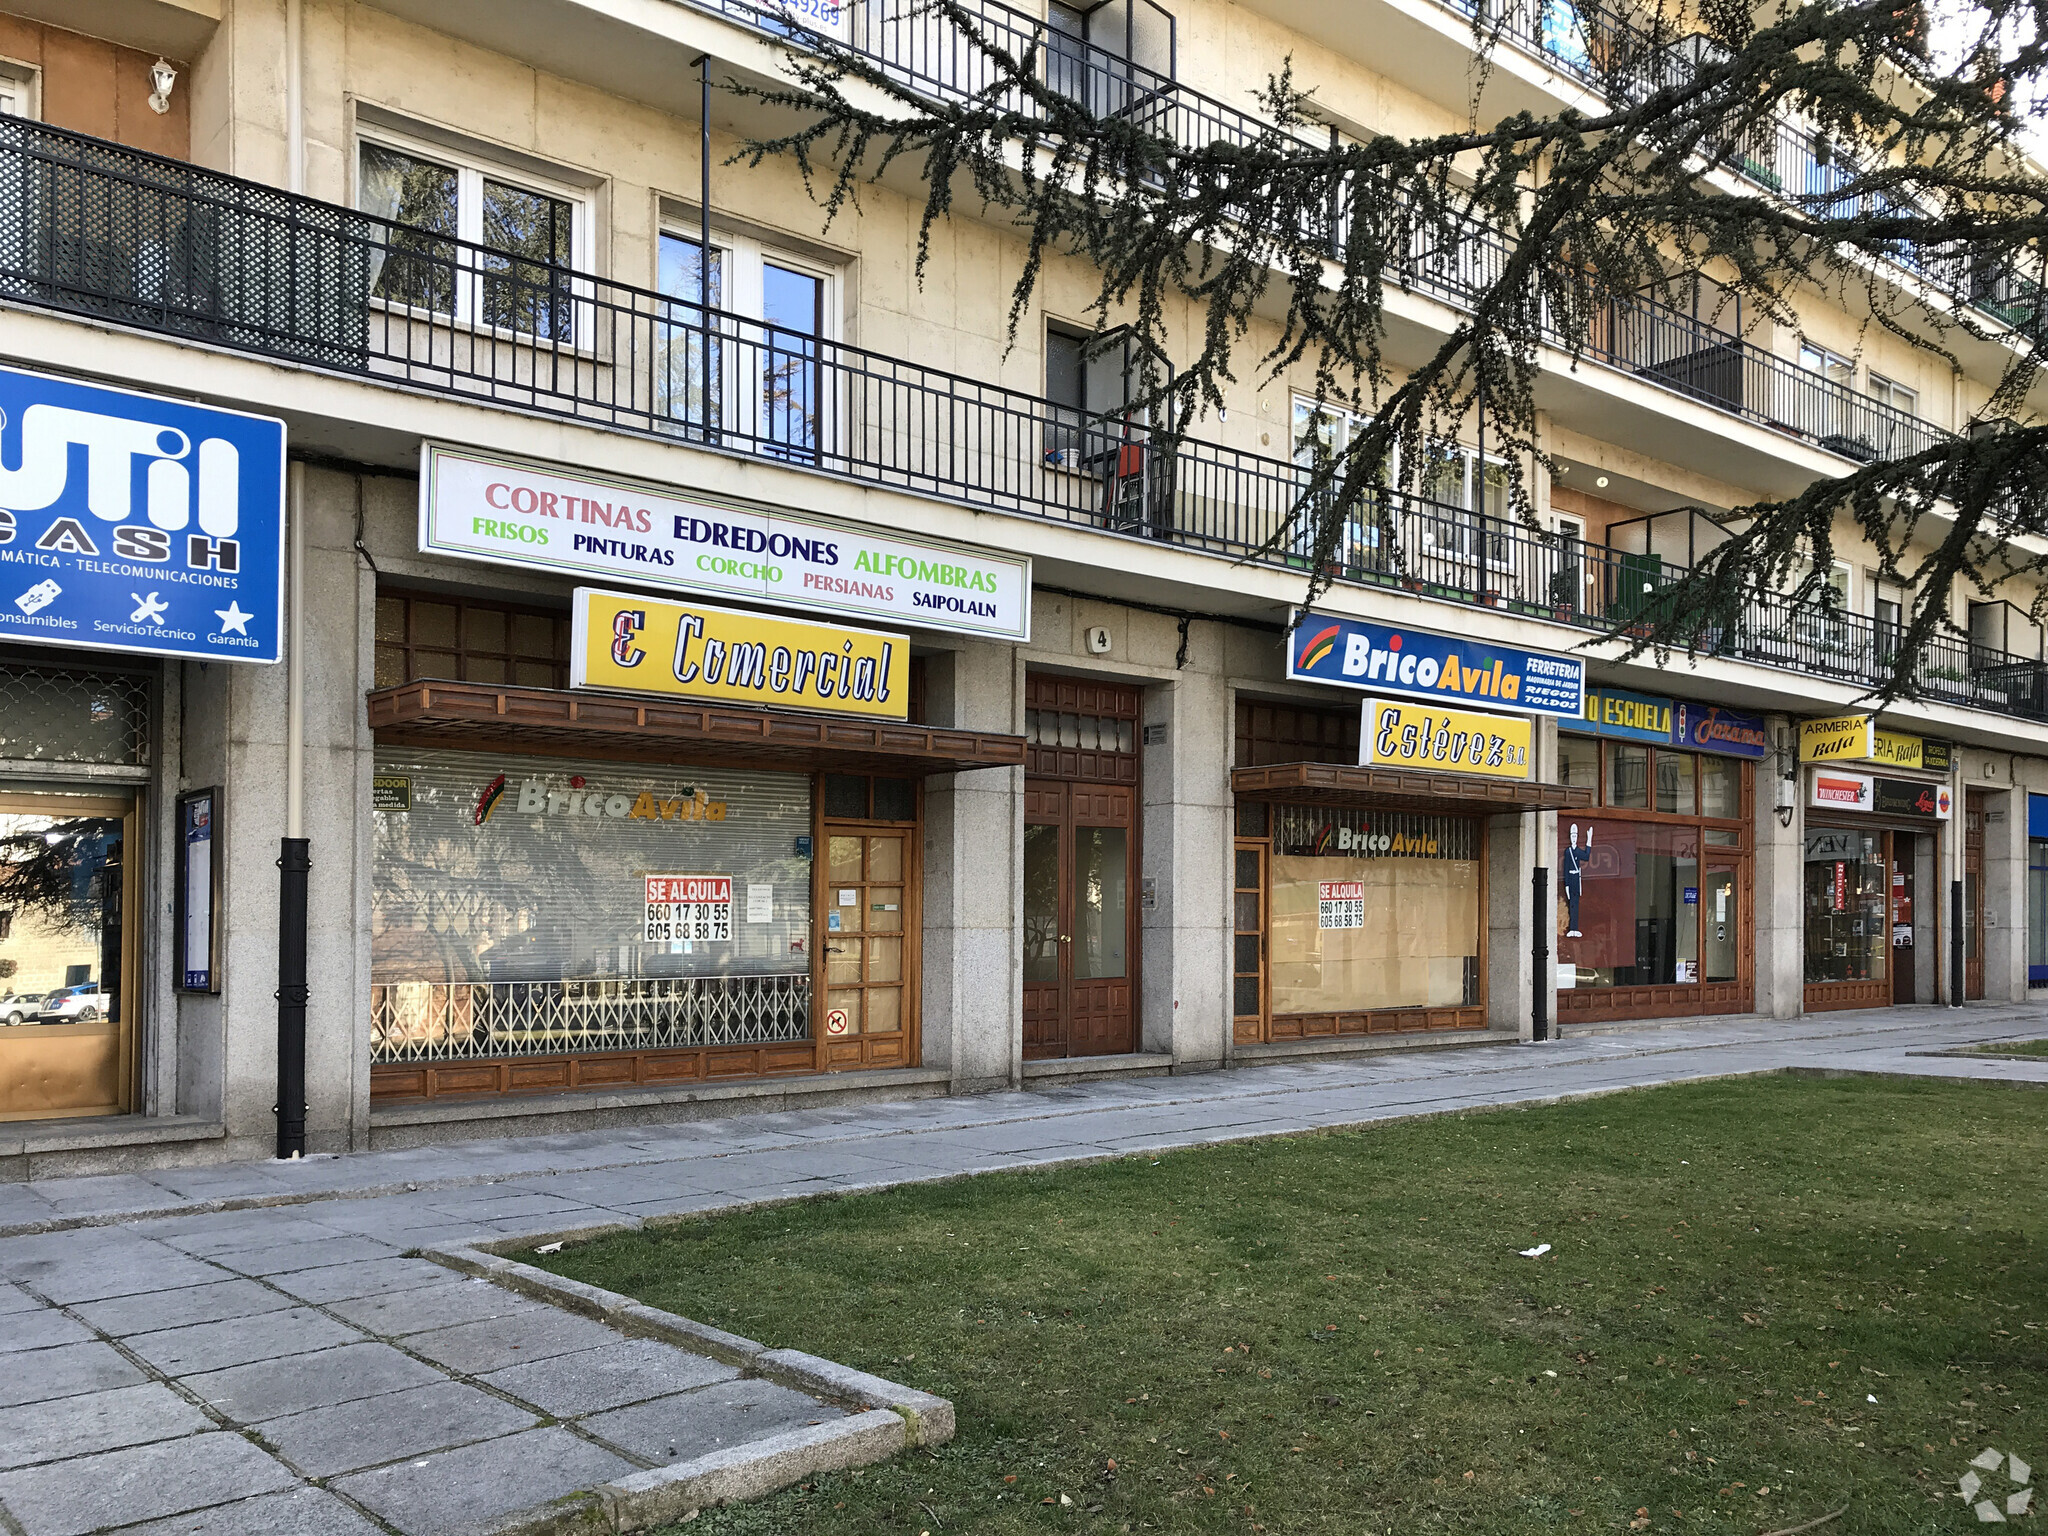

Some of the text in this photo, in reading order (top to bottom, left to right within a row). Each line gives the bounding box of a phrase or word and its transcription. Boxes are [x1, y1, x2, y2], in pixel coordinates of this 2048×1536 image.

[485, 482, 997, 594] CORTINAS EDREDONES ALFOMBRAS
[76, 558, 238, 590] TELECOMUNICACIONES
[472, 516, 997, 618] FRISOS PINTURAS CORCHO PERSIANAS SAIPOLALN
[207, 632, 259, 648] Garantía
[1098, 630, 1107, 647] 4
[672, 613, 893, 703] Comercial
[1342, 633, 1521, 700] BricoAvila
[1526, 657, 1579, 679] FERRETERIA
[1525, 686, 1578, 699] RIEGOS
[1525, 695, 1578, 709] TOLDOS
[1604, 697, 1671, 733] ESCUELA
[1697, 707, 1765, 747] Jarama
[1805, 719, 1863, 735] ARMERIA
[1376, 708, 1506, 767] Estévez
[1812, 735, 1855, 758] Rafa
[1895, 743, 1921, 762] Rafa
[517, 775, 727, 821] BricoAvila
[1819, 788, 1855, 802] WINCHESTER
[1338, 823, 1438, 854] BricoAvila
[648, 881, 729, 901] SE ALQUILA
[1320, 884, 1363, 899] SE ALQUILA
[647, 903, 729, 921] 660 17 30 55
[1320, 900, 1363, 914] 660 17 30 55
[647, 922, 729, 940] 605 68 58 75
[1320, 914, 1363, 928] 605 68 58 75
